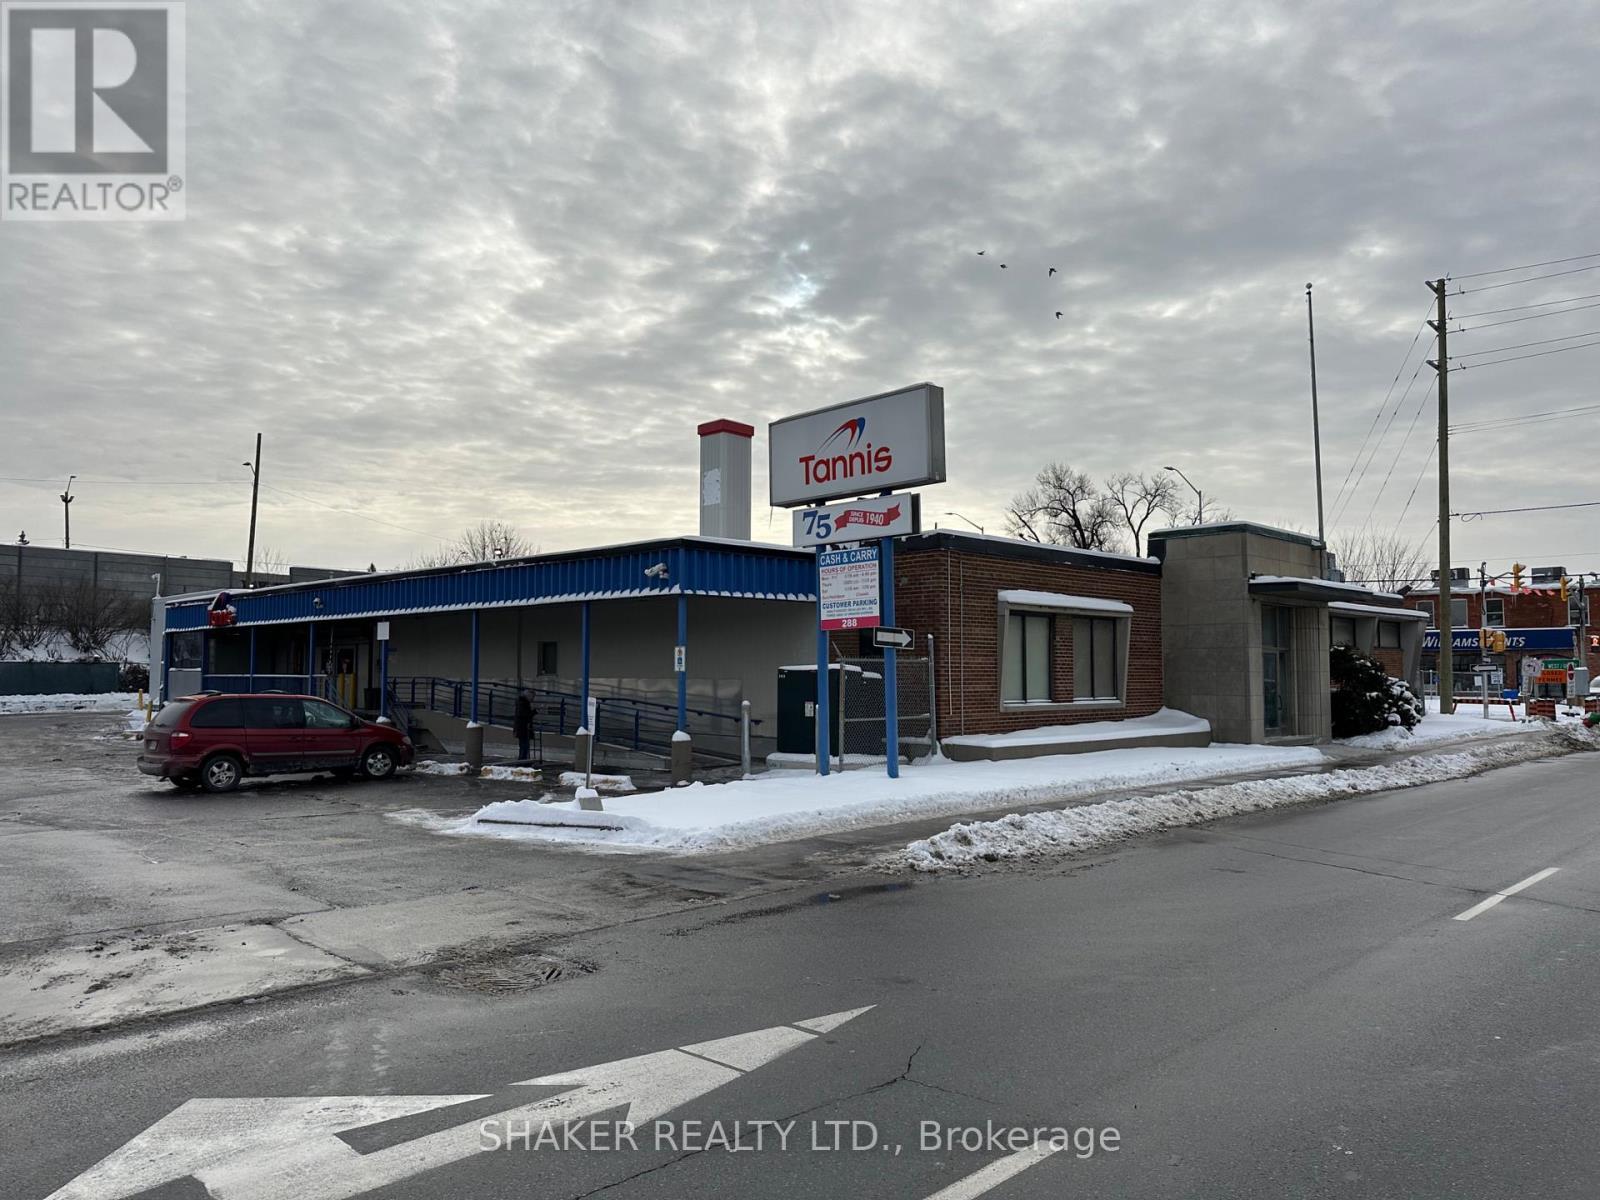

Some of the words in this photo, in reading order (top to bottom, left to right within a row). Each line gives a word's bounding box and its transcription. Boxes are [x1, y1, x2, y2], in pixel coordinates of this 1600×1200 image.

[799, 442, 892, 485] Tannis
[802, 510, 832, 539] 75
[865, 513, 884, 525] 1940
[820, 553, 841, 566] CASH
[843, 553, 849, 563] &
[850, 548, 878, 561] CARRY
[847, 562, 877, 571] OPERATION
[822, 600, 852, 609] CUSTOMER
[853, 598, 878, 607] PARKING
[842, 619, 857, 628] 288
